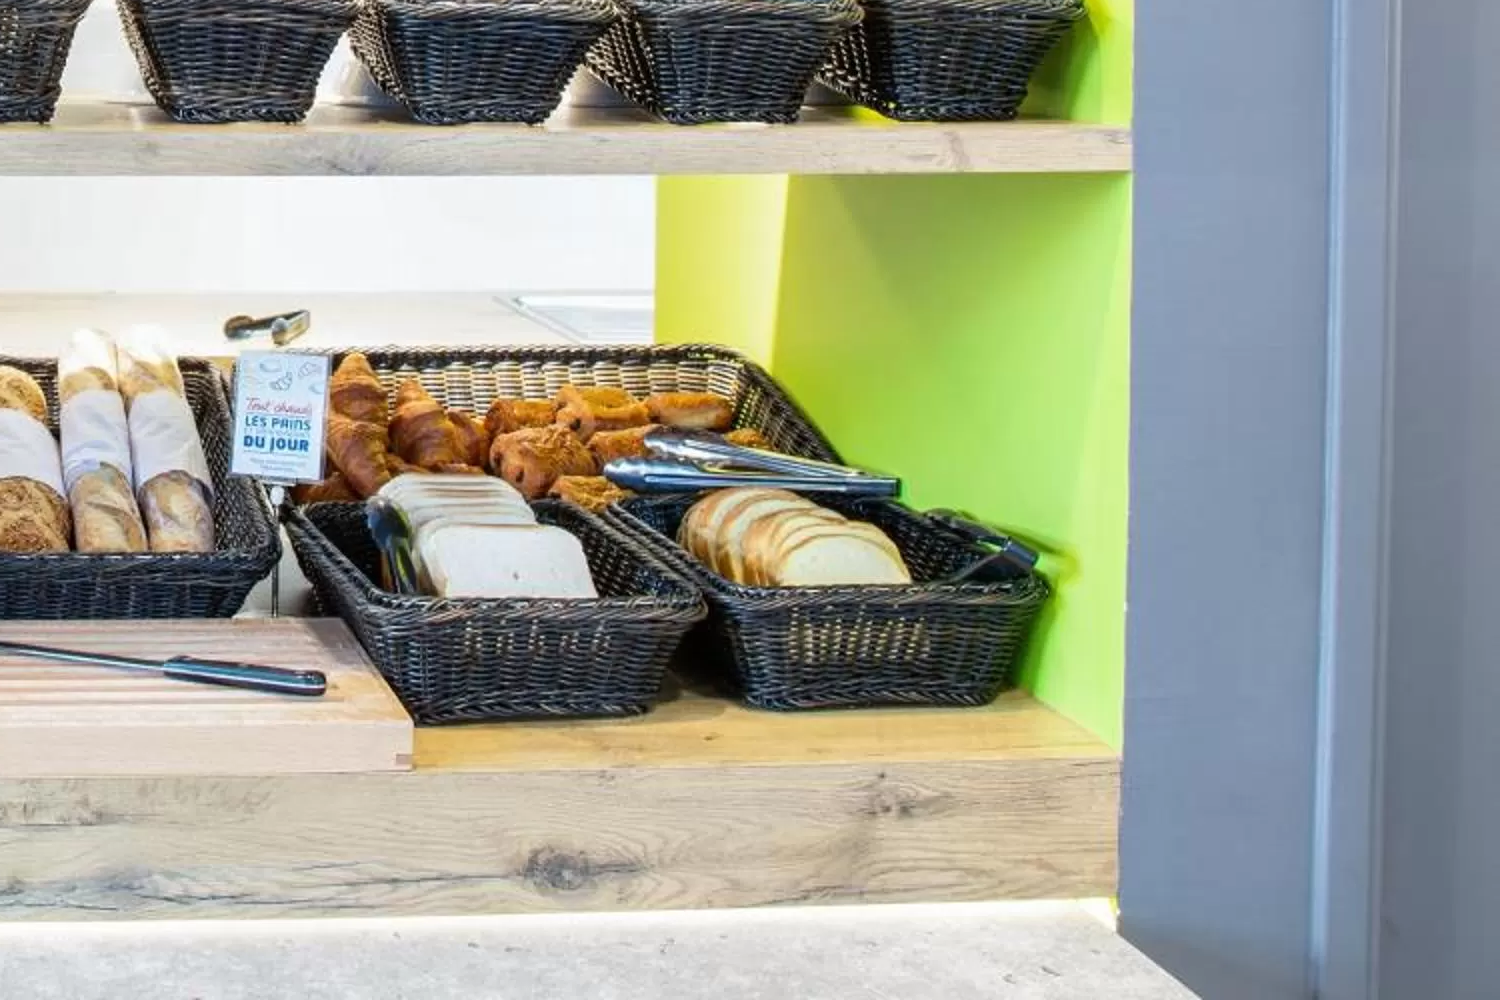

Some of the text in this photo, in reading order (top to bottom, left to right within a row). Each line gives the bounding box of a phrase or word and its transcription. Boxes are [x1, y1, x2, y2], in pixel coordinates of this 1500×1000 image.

[245, 415, 312, 432] LES PAINS
[243, 434, 309, 453] DU JOUR
